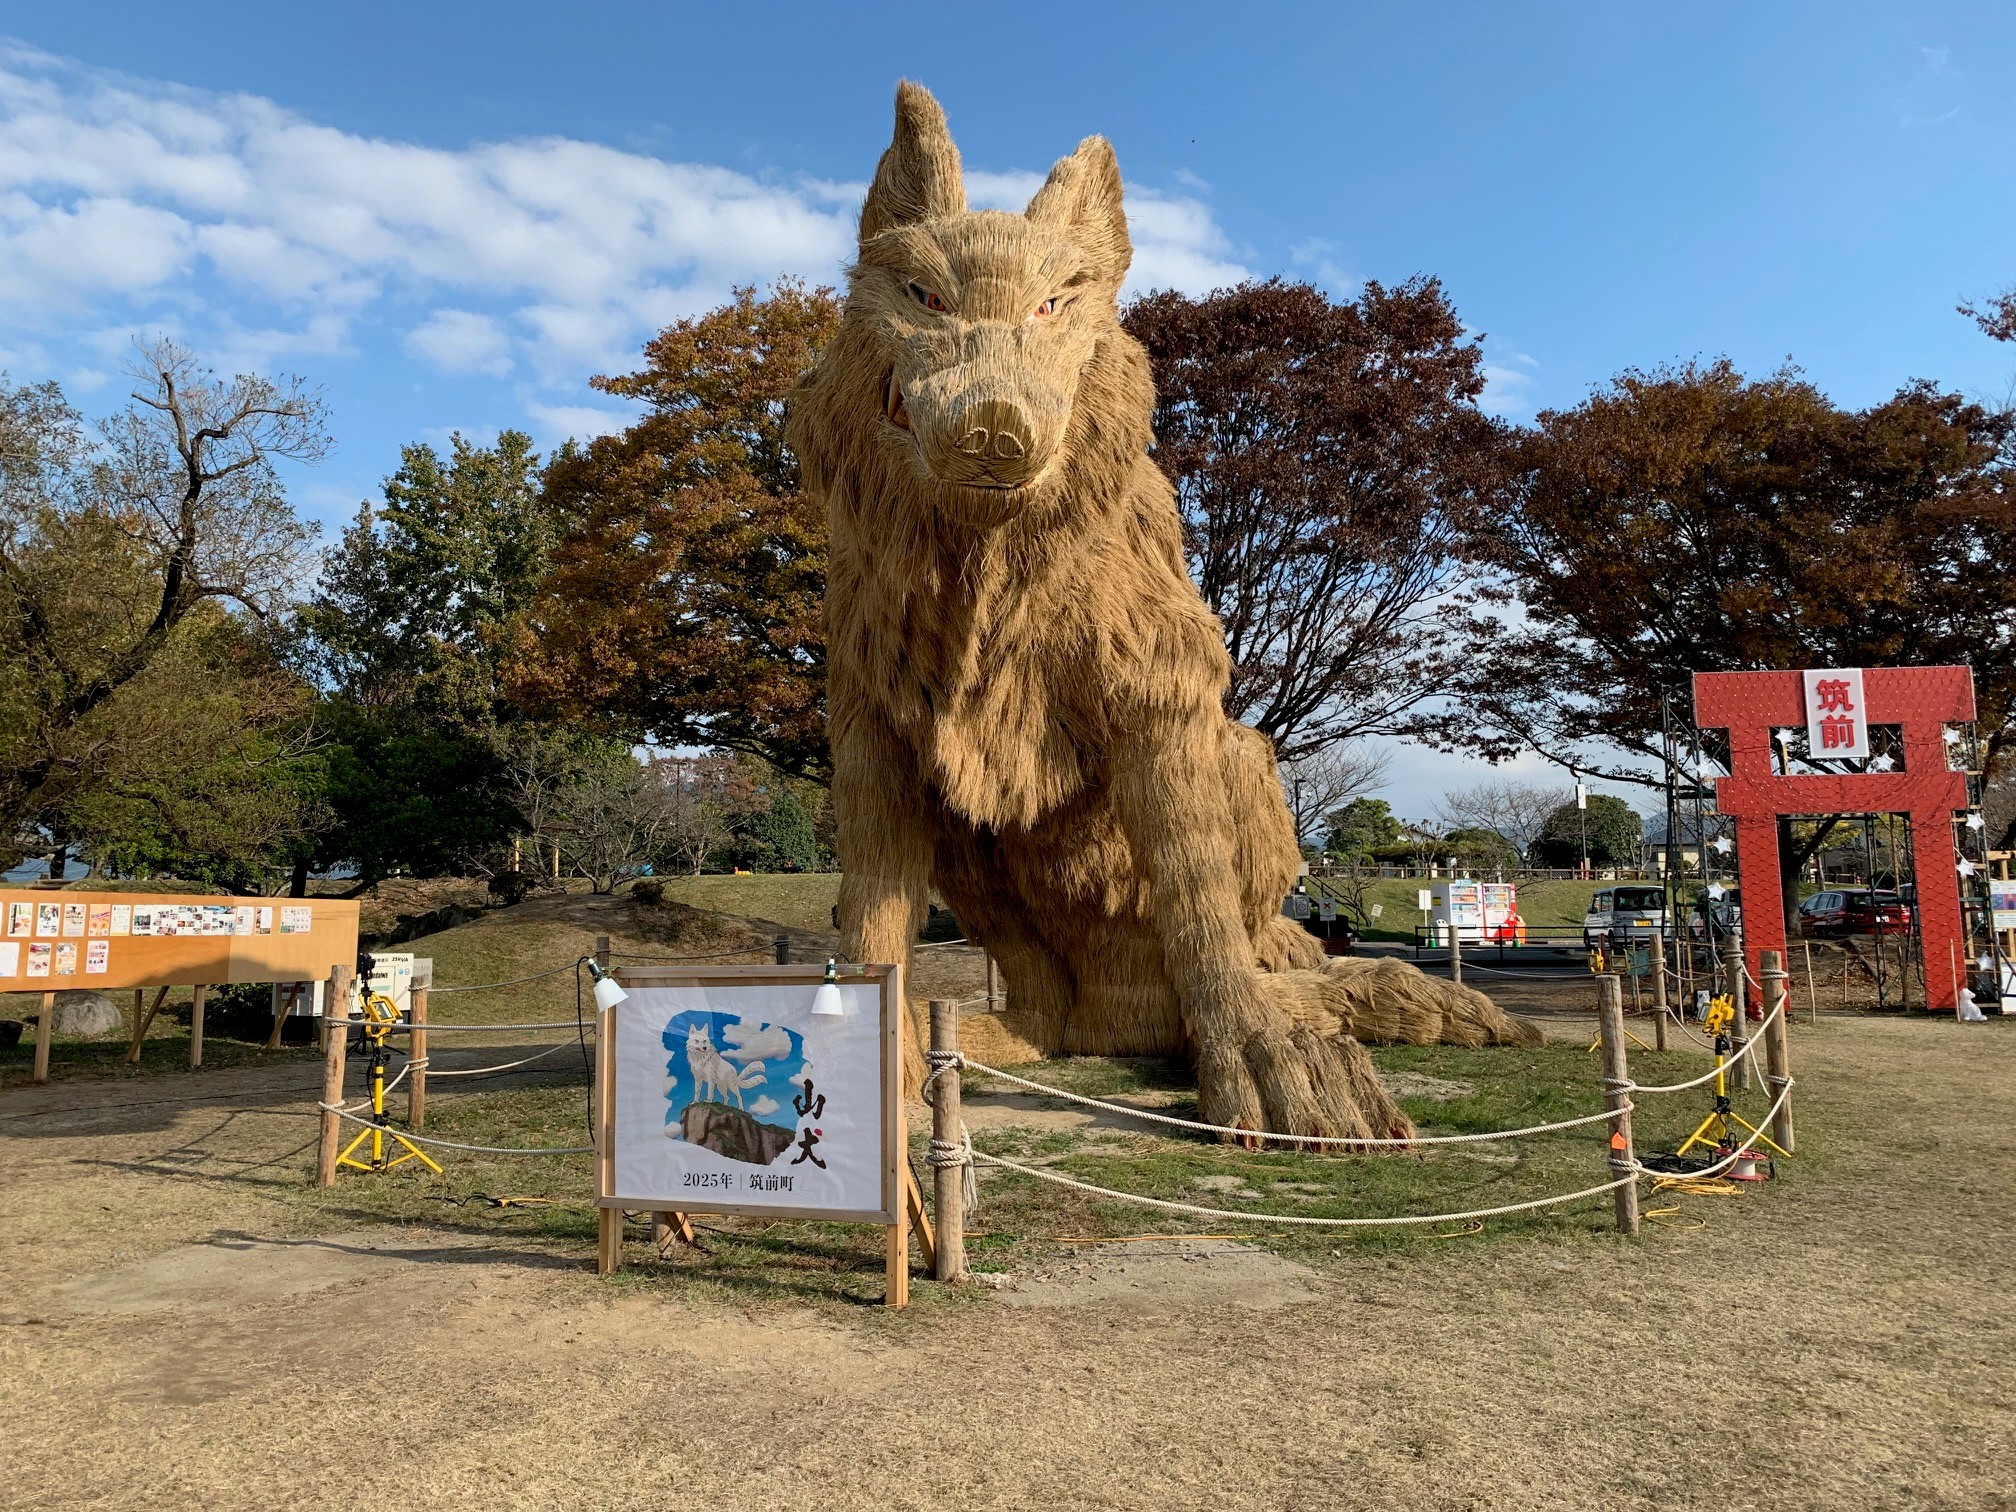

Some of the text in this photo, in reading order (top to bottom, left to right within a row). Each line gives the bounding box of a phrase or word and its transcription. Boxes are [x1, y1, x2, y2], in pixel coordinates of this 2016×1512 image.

[1816, 679, 1855, 749] 筑前
[790, 1078, 827, 1170] 山犬
[683, 1172, 795, 1192] 2025年 筑前町
